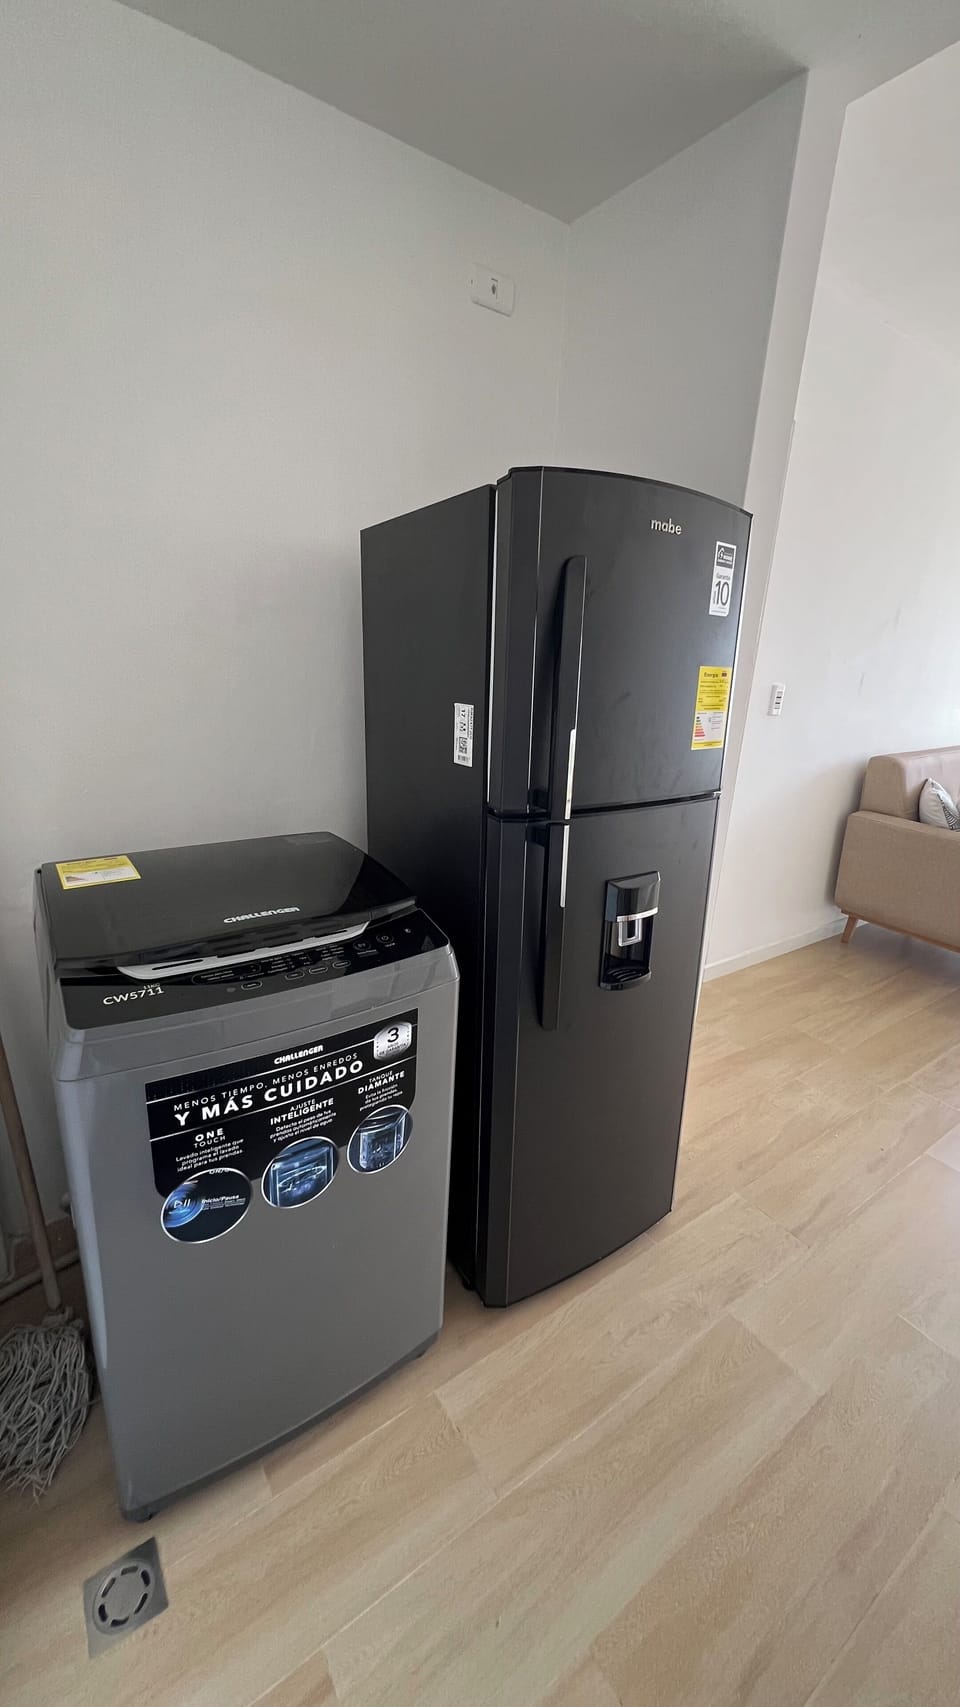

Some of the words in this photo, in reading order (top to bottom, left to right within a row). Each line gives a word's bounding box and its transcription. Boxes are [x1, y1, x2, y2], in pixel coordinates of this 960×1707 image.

[650, 518, 682, 535] mabe
[715, 580, 730, 606] 10
[223, 906, 301, 924] CHALLENGER
[103, 986, 165, 1005] CW5711
[387, 1027, 399, 1043] 3
[274, 1045, 324, 1064] CHALLENGER
[173, 1094, 216, 1112] MENOS
[221, 1082, 267, 1099] TIEMPO,
[272, 1069, 309, 1085] MENOS
[313, 1052, 358, 1073] ENREDOS
[357, 1070, 405, 1095] DIAMANTE
[369, 1070, 393, 1083] TANQUE
[174, 1111, 190, 1126] Y
[201, 1095, 253, 1121] MÁS
[264, 1060, 363, 1102] CUIDADO
[270, 1097, 334, 1126] INTELIGENTE
[290, 1098, 316, 1112] AJUSTE
[193, 1135, 226, 1149] TOUCH
[195, 1127, 223, 1142] ONE
